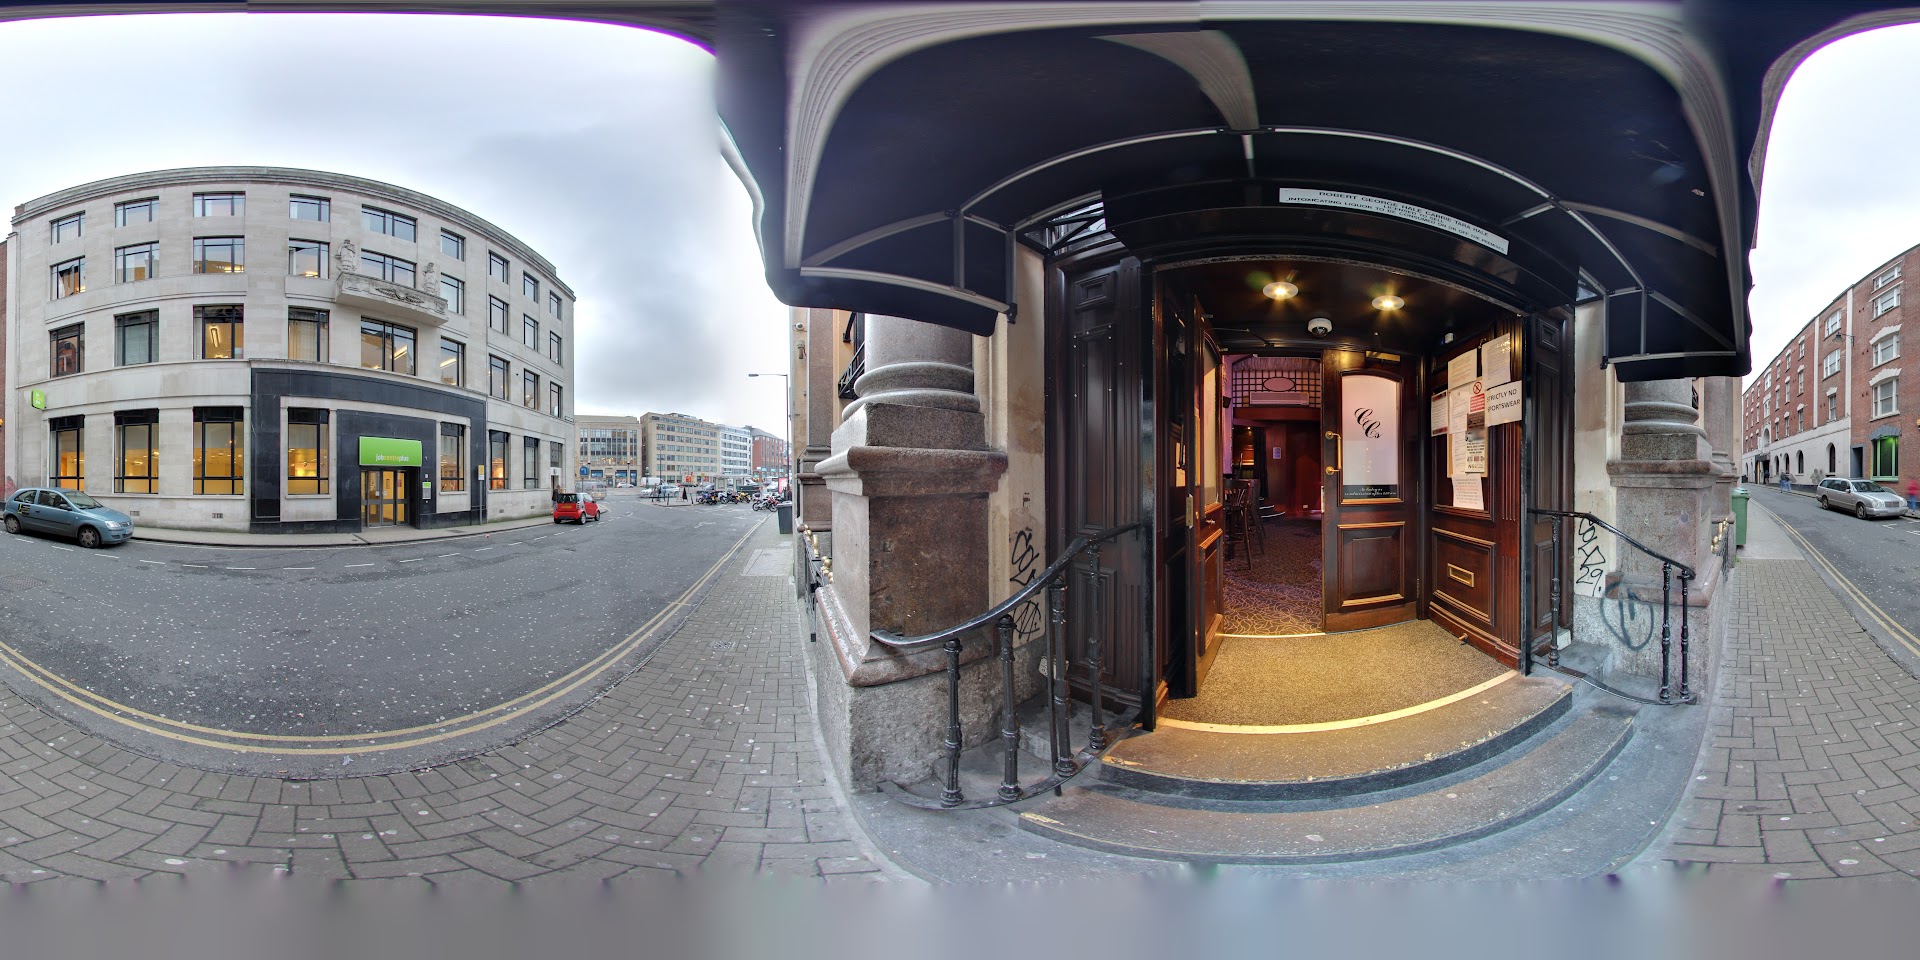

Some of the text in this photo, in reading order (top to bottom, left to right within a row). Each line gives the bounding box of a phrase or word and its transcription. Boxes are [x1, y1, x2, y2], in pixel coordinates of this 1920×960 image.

[1319, 192, 1358, 200] ROBERT
[1361, 197, 1398, 207] GEORGE
[1402, 205, 1422, 213] HALE
[1425, 210, 1451, 223] CARRIE
[1473, 227, 1489, 237] HALE
[1383, 205, 1417, 215] LICENSED
[1288, 197, 1342, 205] INTOXICATING
[1344, 202, 1373, 210] LIQUOR
[1399, 212, 1436, 224] CONSUMED
[1481, 239, 1505, 252] PREMISES
[1487, 391, 1508, 403] STRICTLY
[1508, 388, 1517, 396] NO
[1487, 399, 1521, 413] SPORTSWEAR
